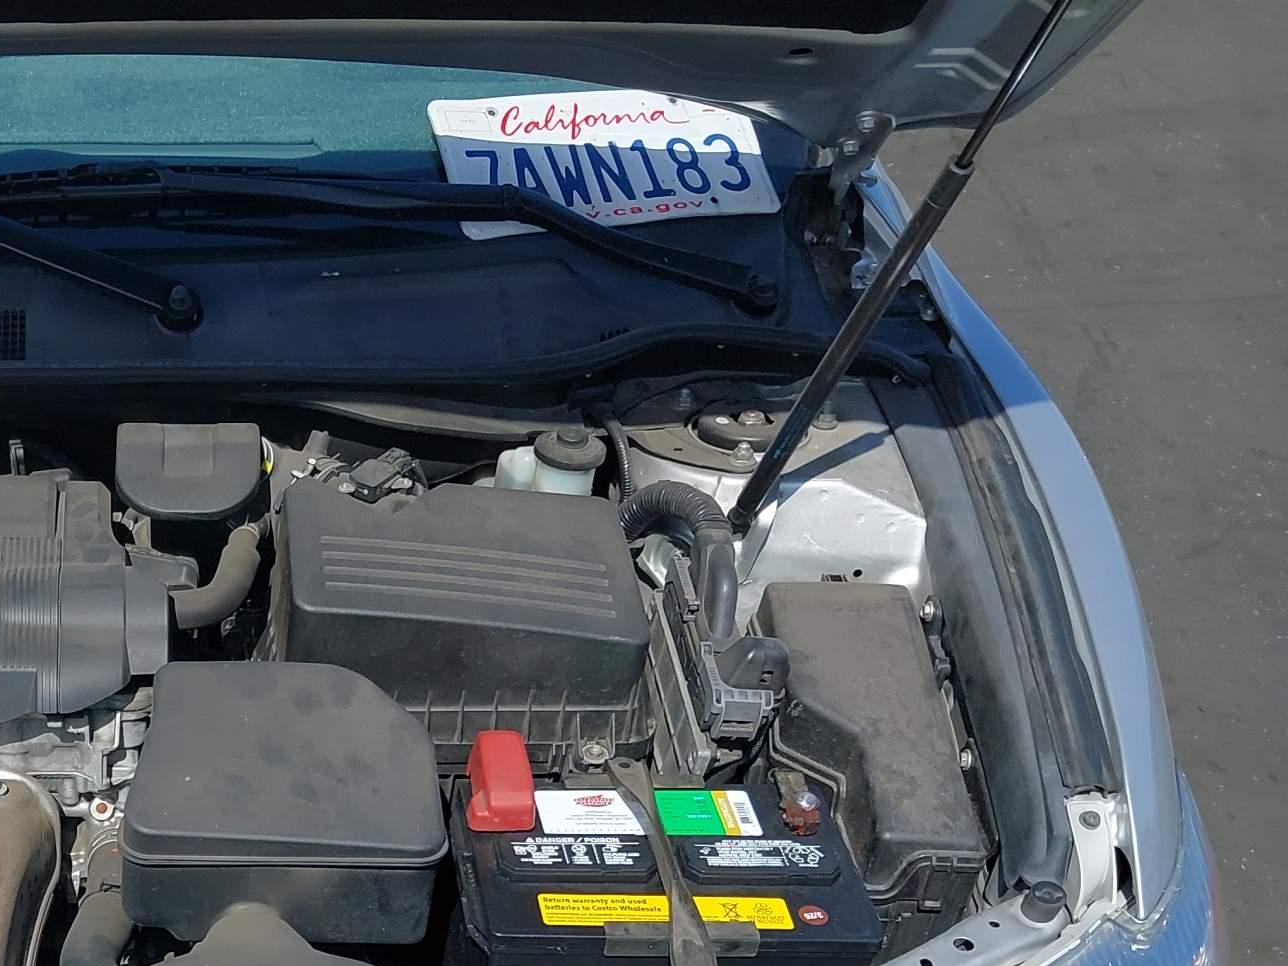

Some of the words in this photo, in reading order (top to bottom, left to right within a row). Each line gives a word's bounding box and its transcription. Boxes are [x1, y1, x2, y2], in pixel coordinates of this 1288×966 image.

[500, 102, 690, 139] California
[465, 133, 751, 208] 7AWN183
[586, 199, 704, 219] v.ca.gov
